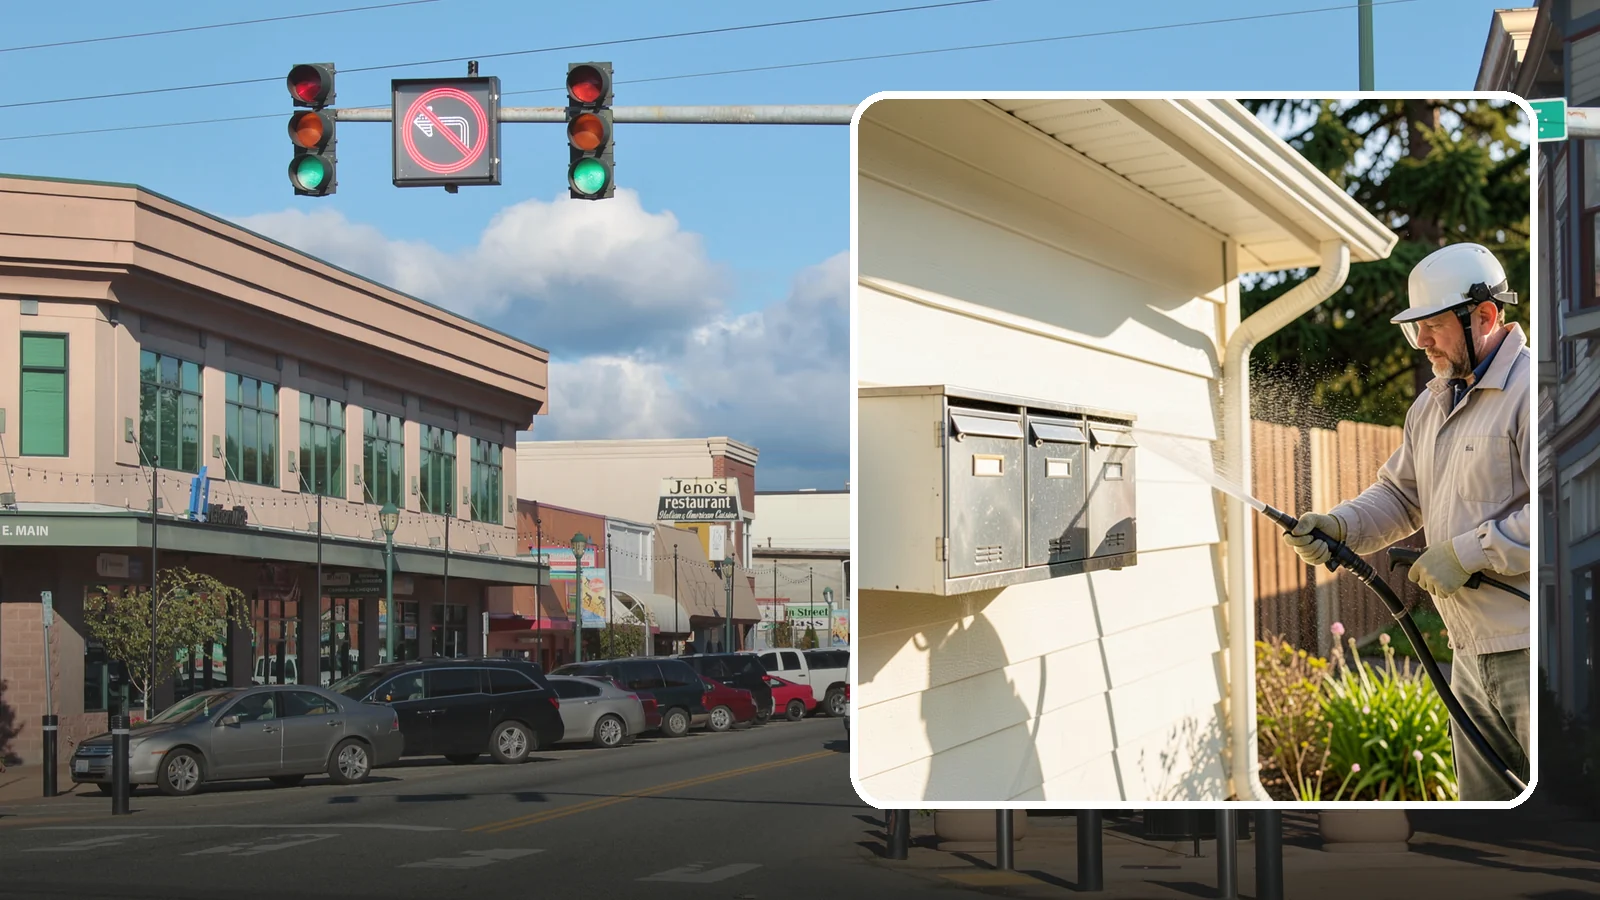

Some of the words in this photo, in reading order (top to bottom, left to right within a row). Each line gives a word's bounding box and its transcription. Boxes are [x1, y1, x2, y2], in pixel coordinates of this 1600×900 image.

[670, 480, 727, 494] Jeno's
[665, 496, 731, 509] restaurant
[686, 509, 714, 519] American
[715, 509, 737, 519] Cuisine
[2, 525, 13, 536] E.
[15, 525, 49, 536] MAIN
[797, 607, 828, 617] Street
